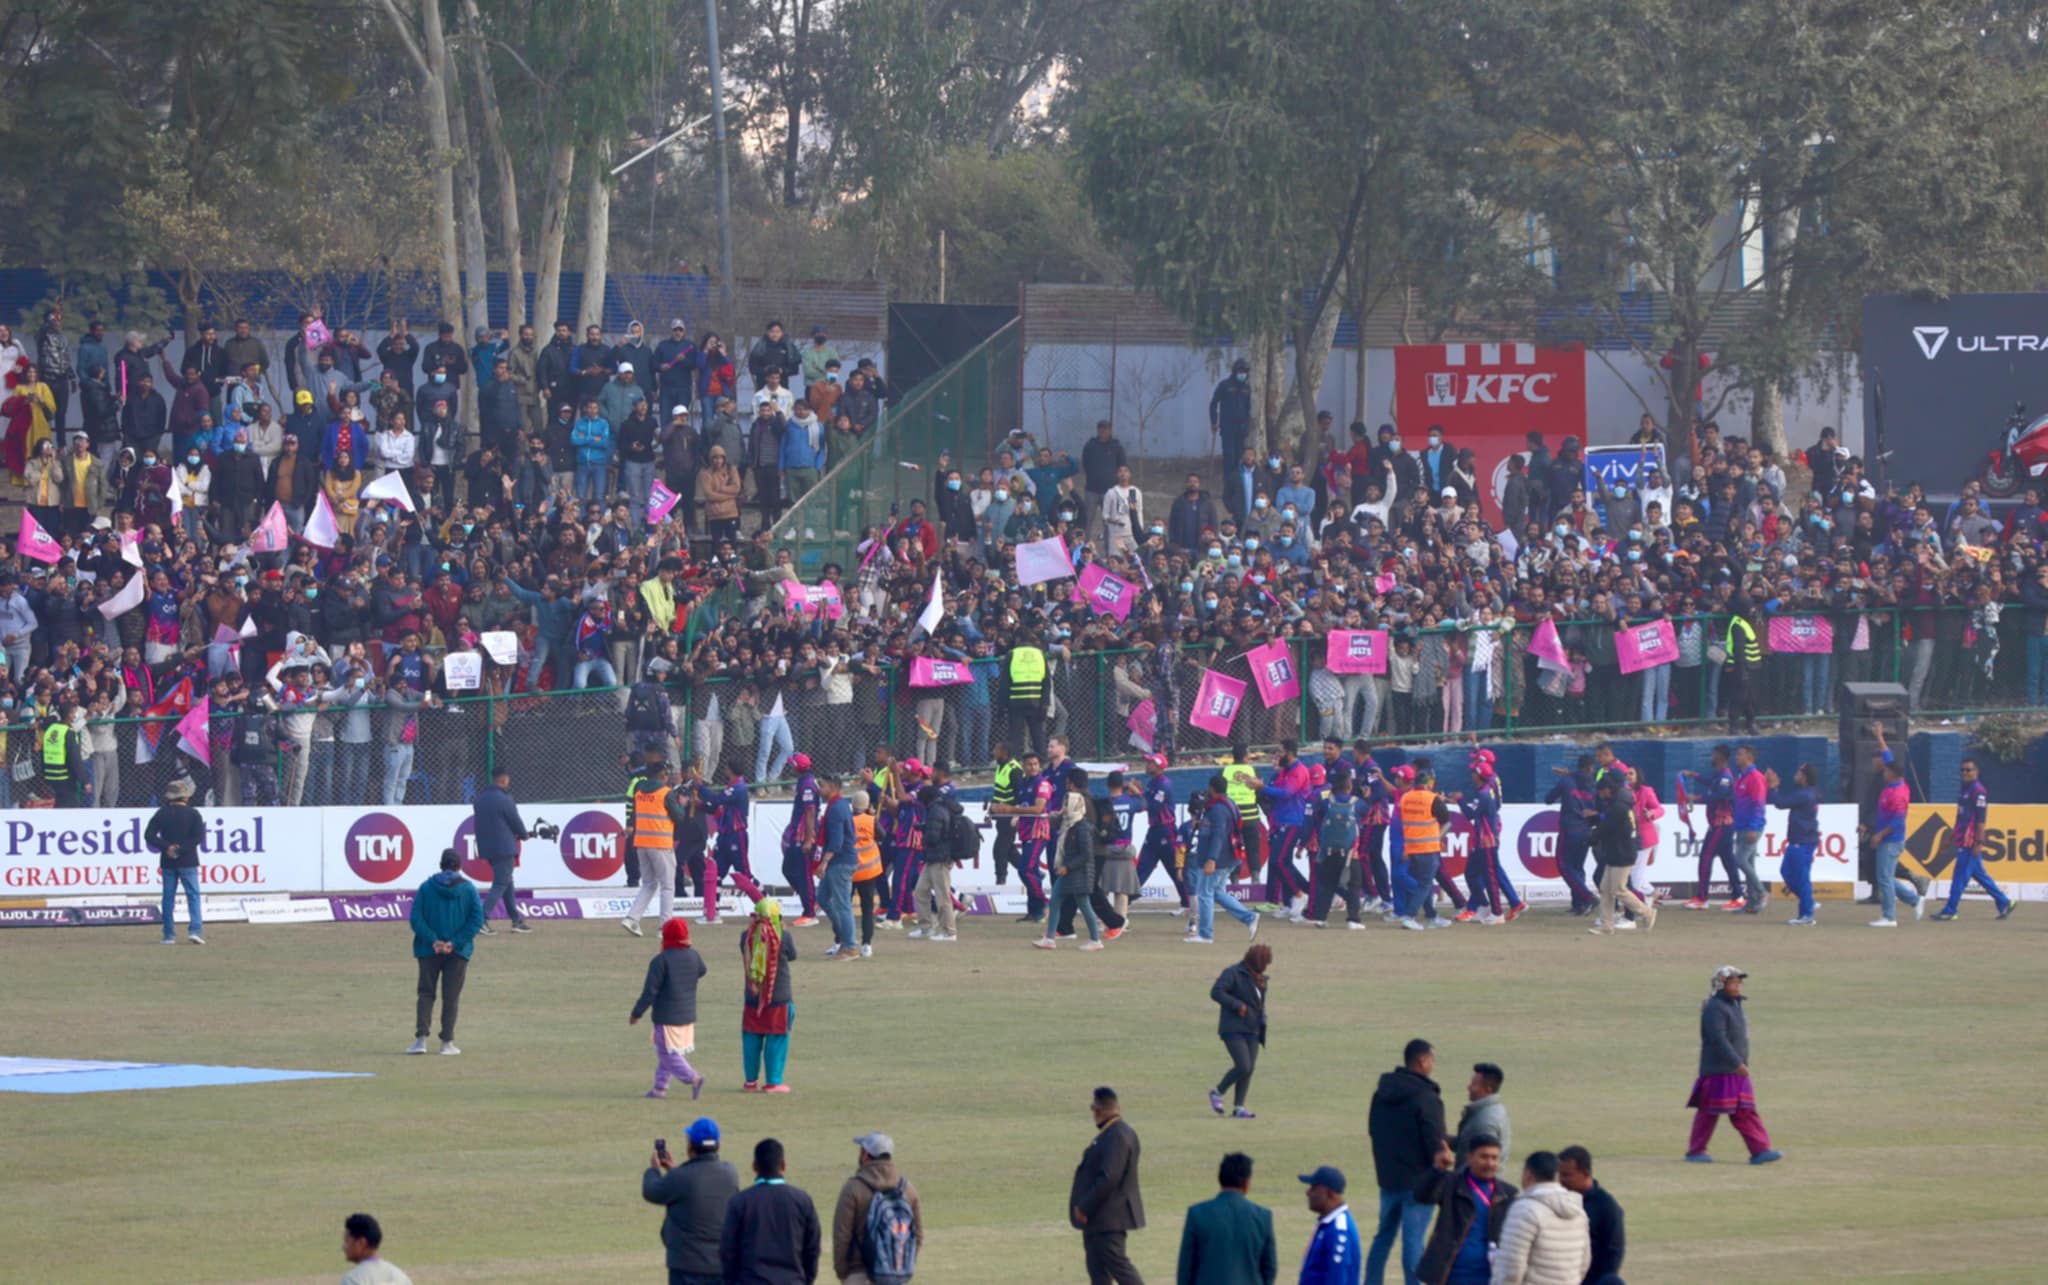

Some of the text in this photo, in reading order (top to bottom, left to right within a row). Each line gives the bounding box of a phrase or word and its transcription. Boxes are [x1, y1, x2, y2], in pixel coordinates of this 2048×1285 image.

[1461, 373, 1552, 404] KFC
[5, 816, 266, 856] Presidtial
[355, 834, 403, 861] TCM
[570, 832, 617, 859] TCM
[1527, 832, 1559, 857] TC
[1981, 828, 2048, 862] Sid
[5, 866, 150, 887] GRADUATE
[607, 900, 632, 911] SP
[1226, 887, 1250, 900] cell
[343, 903, 403, 919] Ncell
